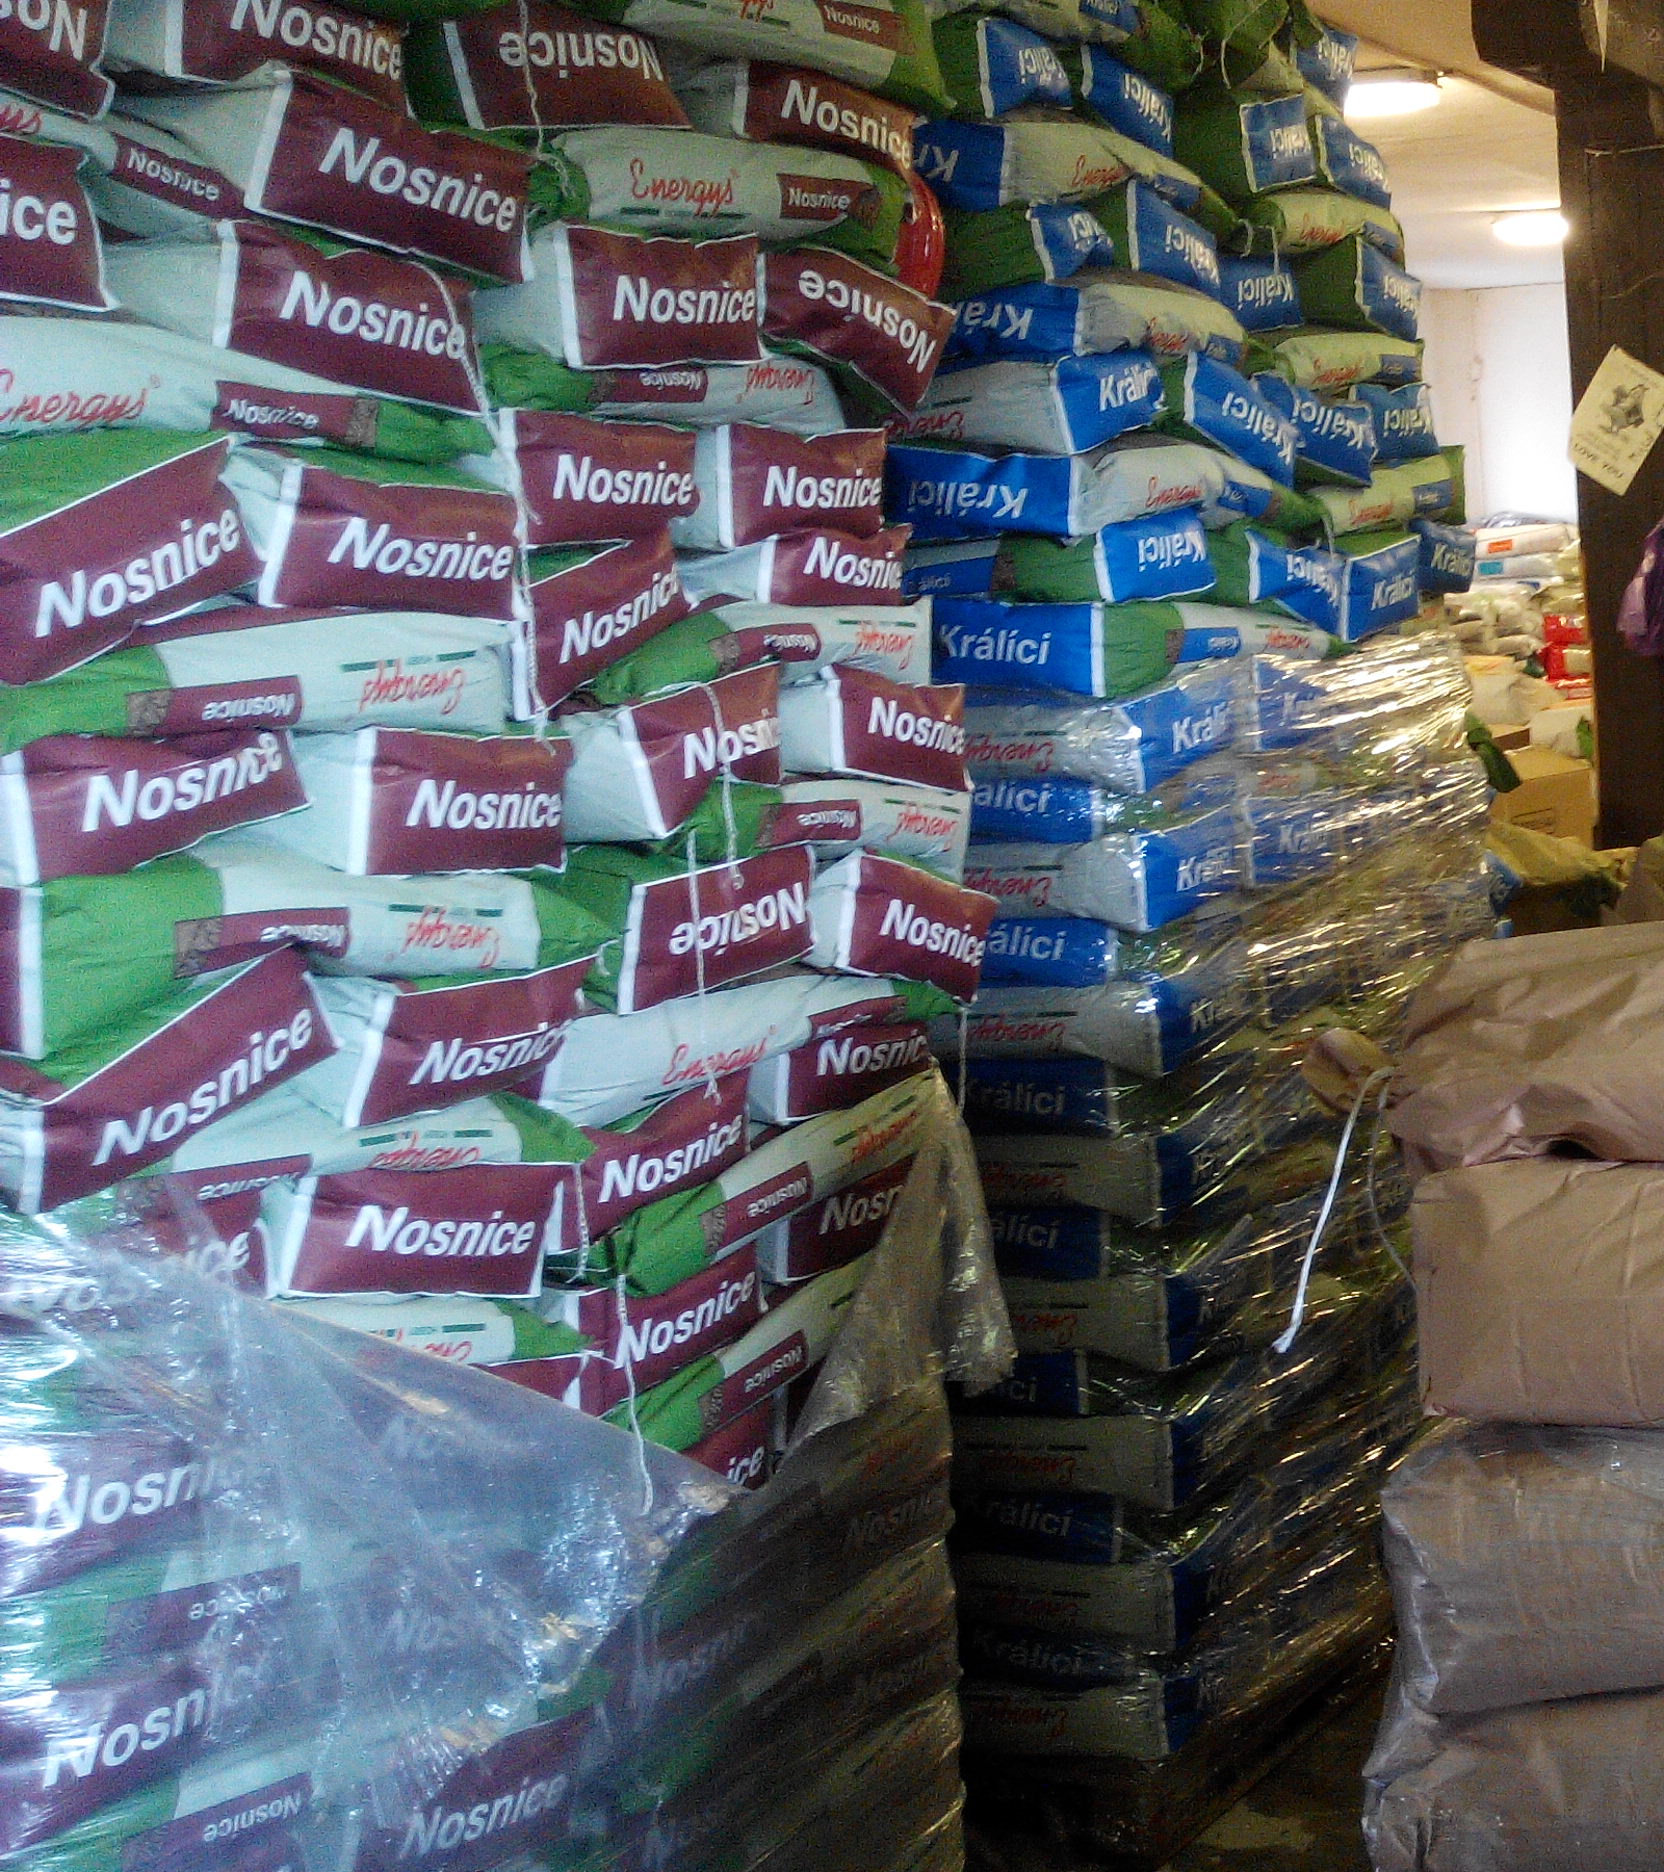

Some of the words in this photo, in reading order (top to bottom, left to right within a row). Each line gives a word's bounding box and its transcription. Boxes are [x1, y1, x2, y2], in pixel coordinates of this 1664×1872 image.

[500, 32, 664, 81] Nosnice
[781, 79, 912, 170] Nosnice
[127, 148, 220, 201] Nosnice
[318, 127, 518, 233] Nosnice
[631, 158, 733, 218] Energys
[0, 180, 77, 244] ice
[279, 271, 465, 360] Nosnice
[613, 275, 756, 324] Nosnice
[800, 269, 937, 374] Nosnice
[553, 454, 695, 506] Nosnice
[763, 465, 883, 509] Nosnice
[910, 478, 1028, 518] Králíci
[36, 510, 240, 637] Nosnice
[328, 517, 513, 581] Nosnice
[940, 624, 1050, 665] Králíci
[203, 694, 295, 723] Nosnice
[359, 660, 466, 714] Energys
[868, 697, 964, 754] Nosnice
[406, 779, 561, 830] Nosnice
[670, 883, 806, 956] Nosnice
[881, 898, 985, 967] Nosnice
[92, 1008, 312, 1166] Nosnice
[599, 1115, 741, 1203] Nosnice
[747, 1177, 808, 1219] Nosnice
[347, 1205, 534, 1255] Nosnice
[616, 1269, 755, 1368] Nosnice
[745, 1348, 804, 1393] Nosnice
[402, 1773, 567, 1856] Nosnice
